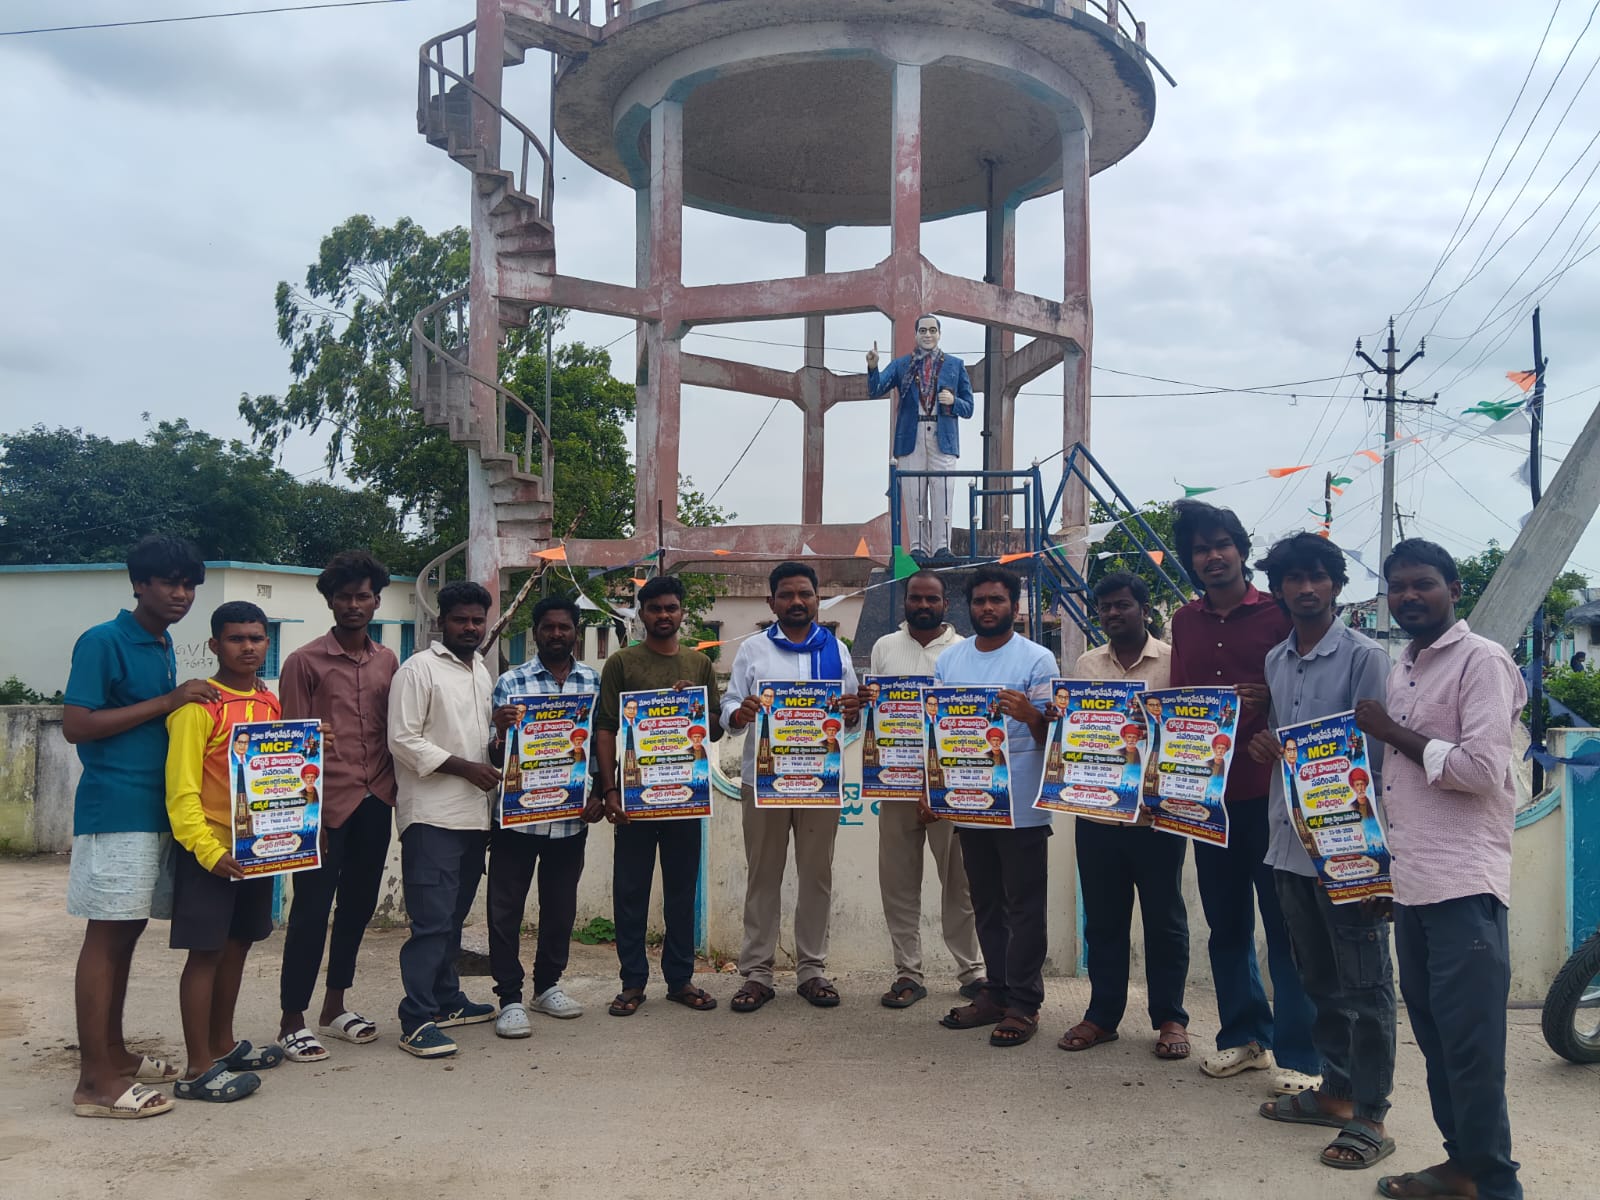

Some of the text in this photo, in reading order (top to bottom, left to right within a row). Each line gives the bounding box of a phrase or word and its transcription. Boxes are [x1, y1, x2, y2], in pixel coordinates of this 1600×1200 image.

[889, 691, 919, 700] MCF
[785, 697, 816, 707] MCF
[1081, 699, 1115, 710] MCF
[535, 709, 567, 720] MCF
[648, 705, 679, 717] MCF
[948, 705, 978, 715] MCF
[1174, 706, 1209, 718] MCF
[260, 741, 293, 753] MCF
[1307, 741, 1339, 760] MCF
